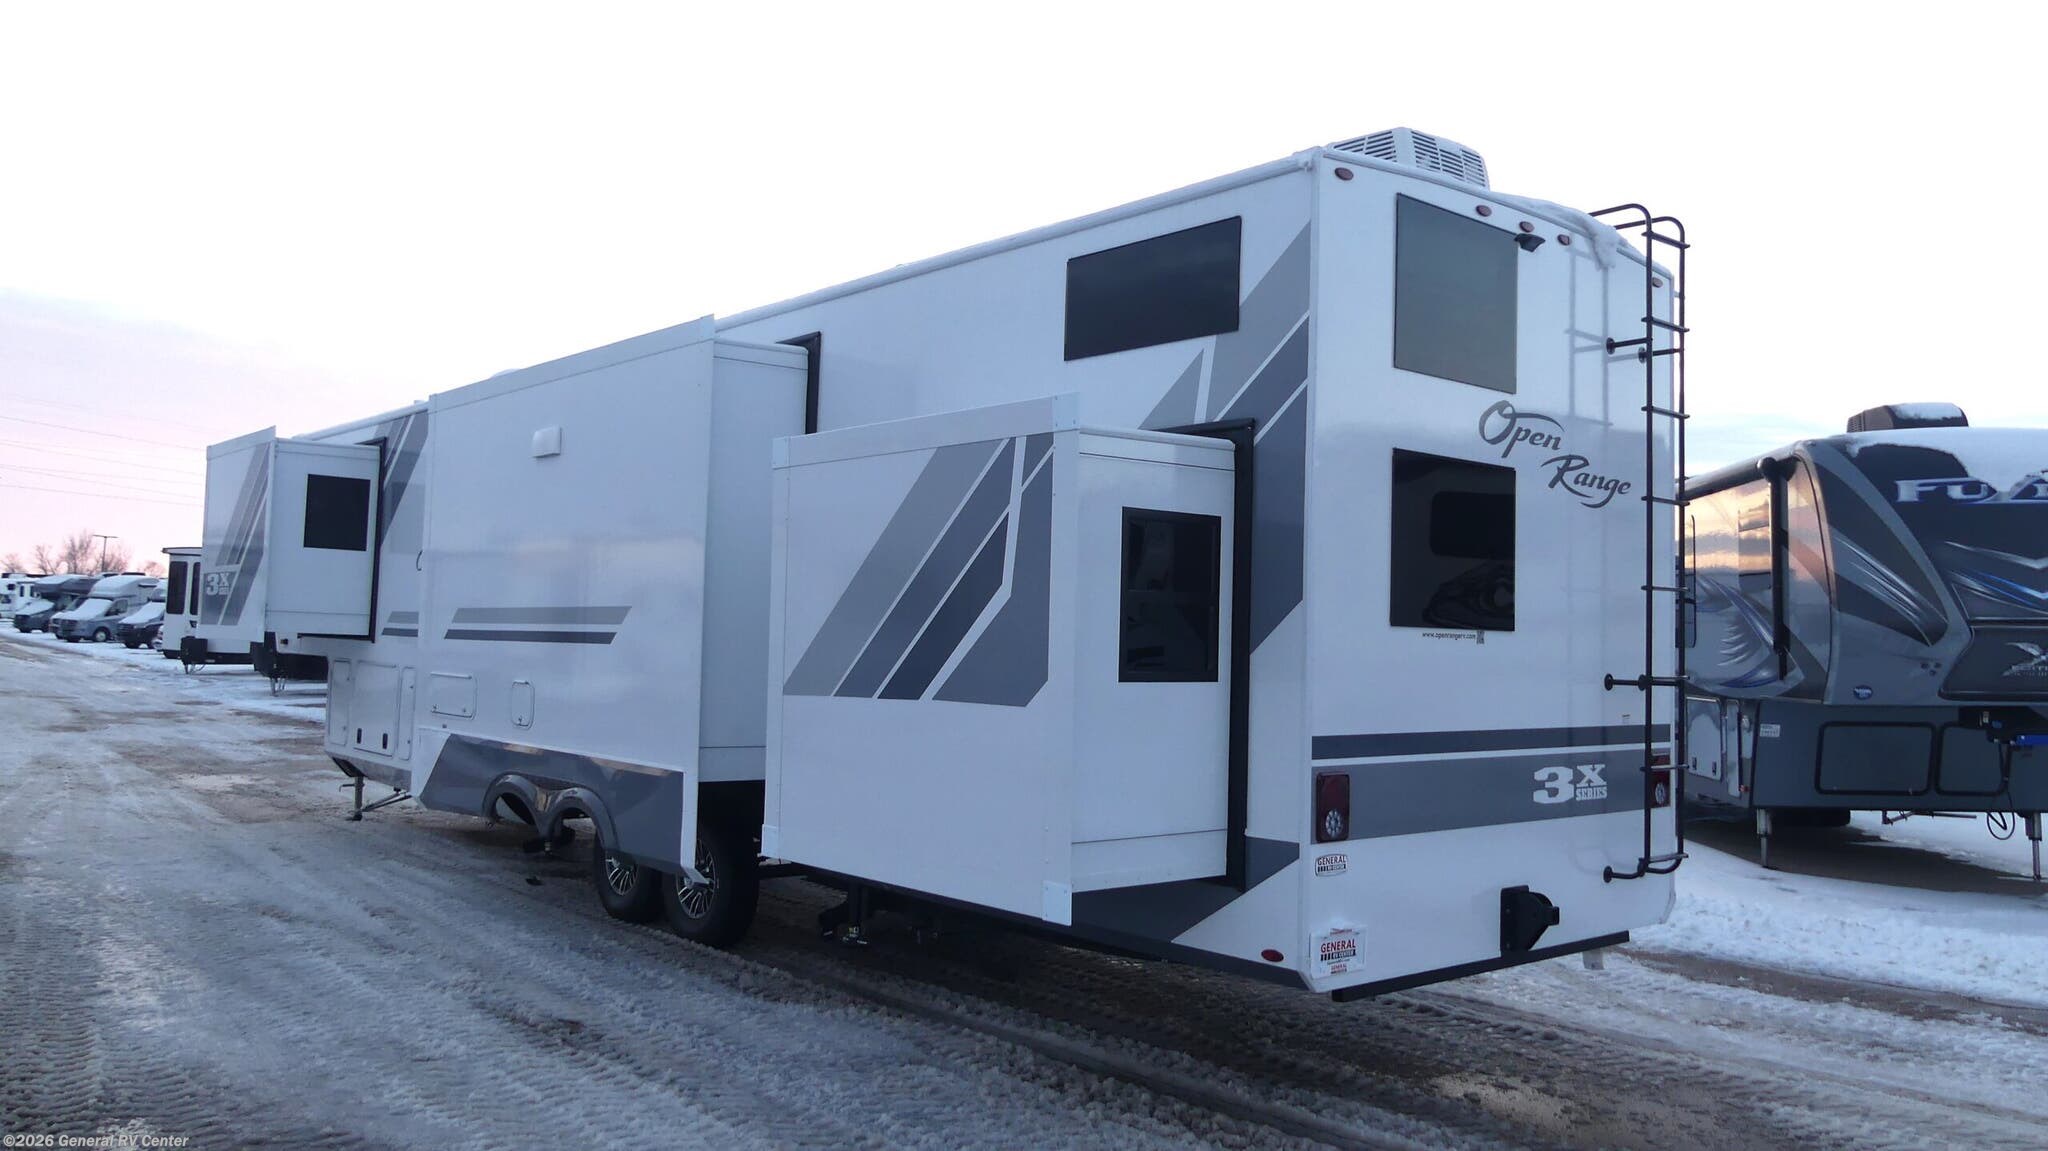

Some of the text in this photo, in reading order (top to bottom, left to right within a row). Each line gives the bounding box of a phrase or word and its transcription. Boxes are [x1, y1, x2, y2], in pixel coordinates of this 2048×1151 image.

[1479, 400, 1565, 459] Open
[1541, 454, 1632, 509] Range
[1575, 787, 1608, 801] SERIES
[1317, 855, 1346, 866] GENERAL
[1320, 938, 1356, 953] GENERAL
